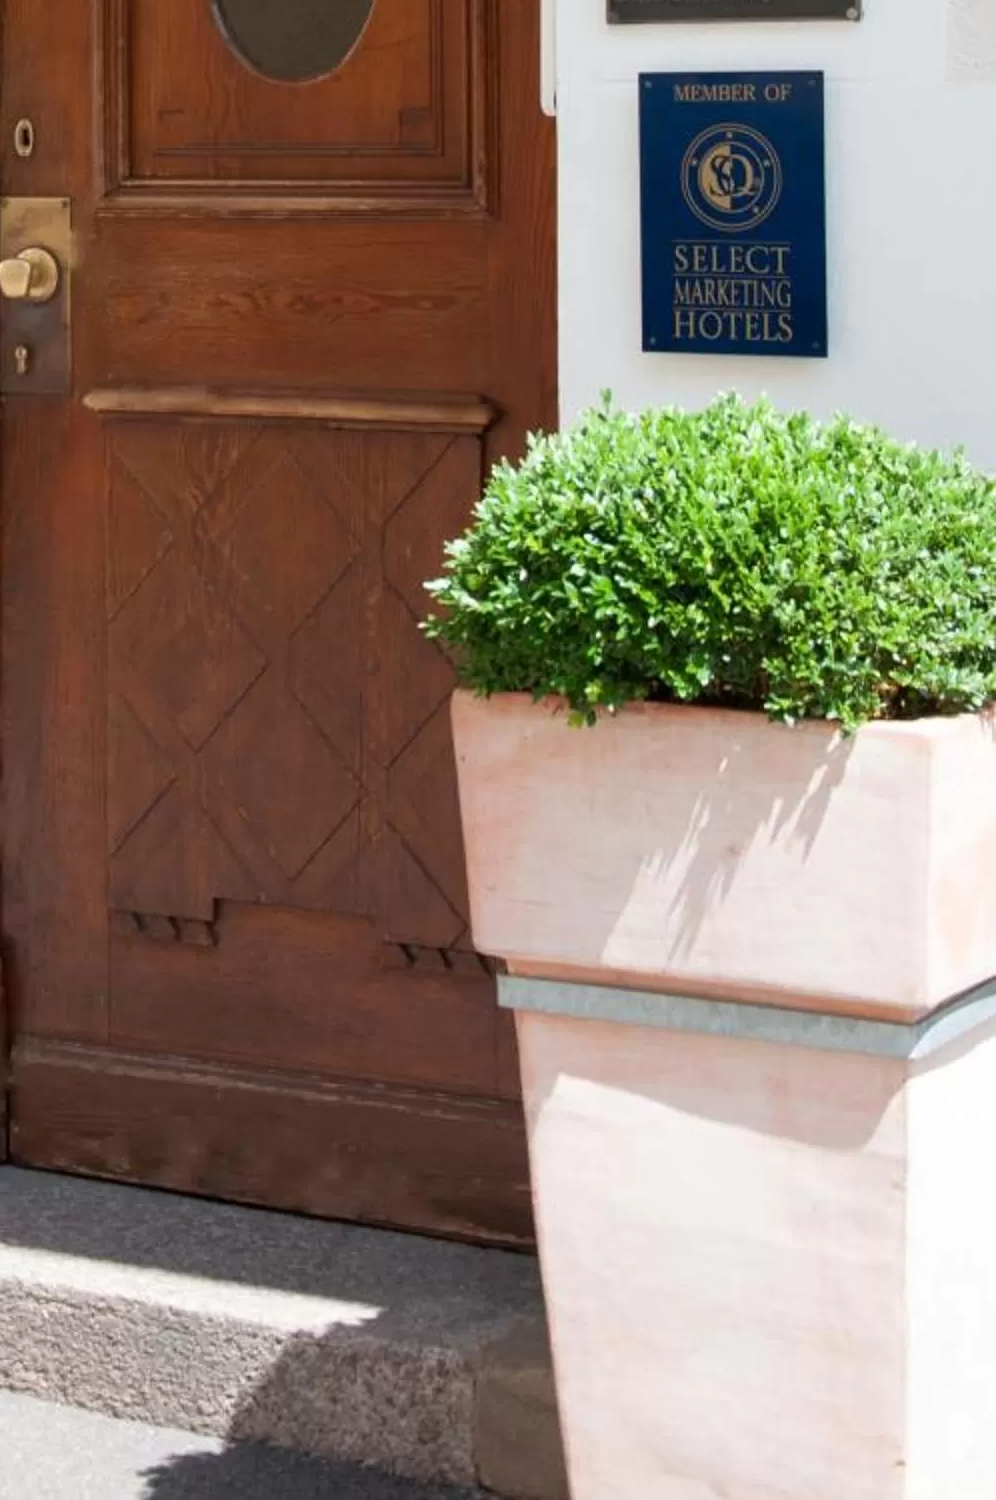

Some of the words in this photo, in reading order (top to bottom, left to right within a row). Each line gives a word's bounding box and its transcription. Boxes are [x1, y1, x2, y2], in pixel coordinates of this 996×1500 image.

[673, 84, 756, 102] MEMBER
[763, 83, 793, 101] OF
[674, 245, 791, 274] SELECT
[673, 277, 792, 308] MARKETING
[673, 310, 793, 343] HOTELS
